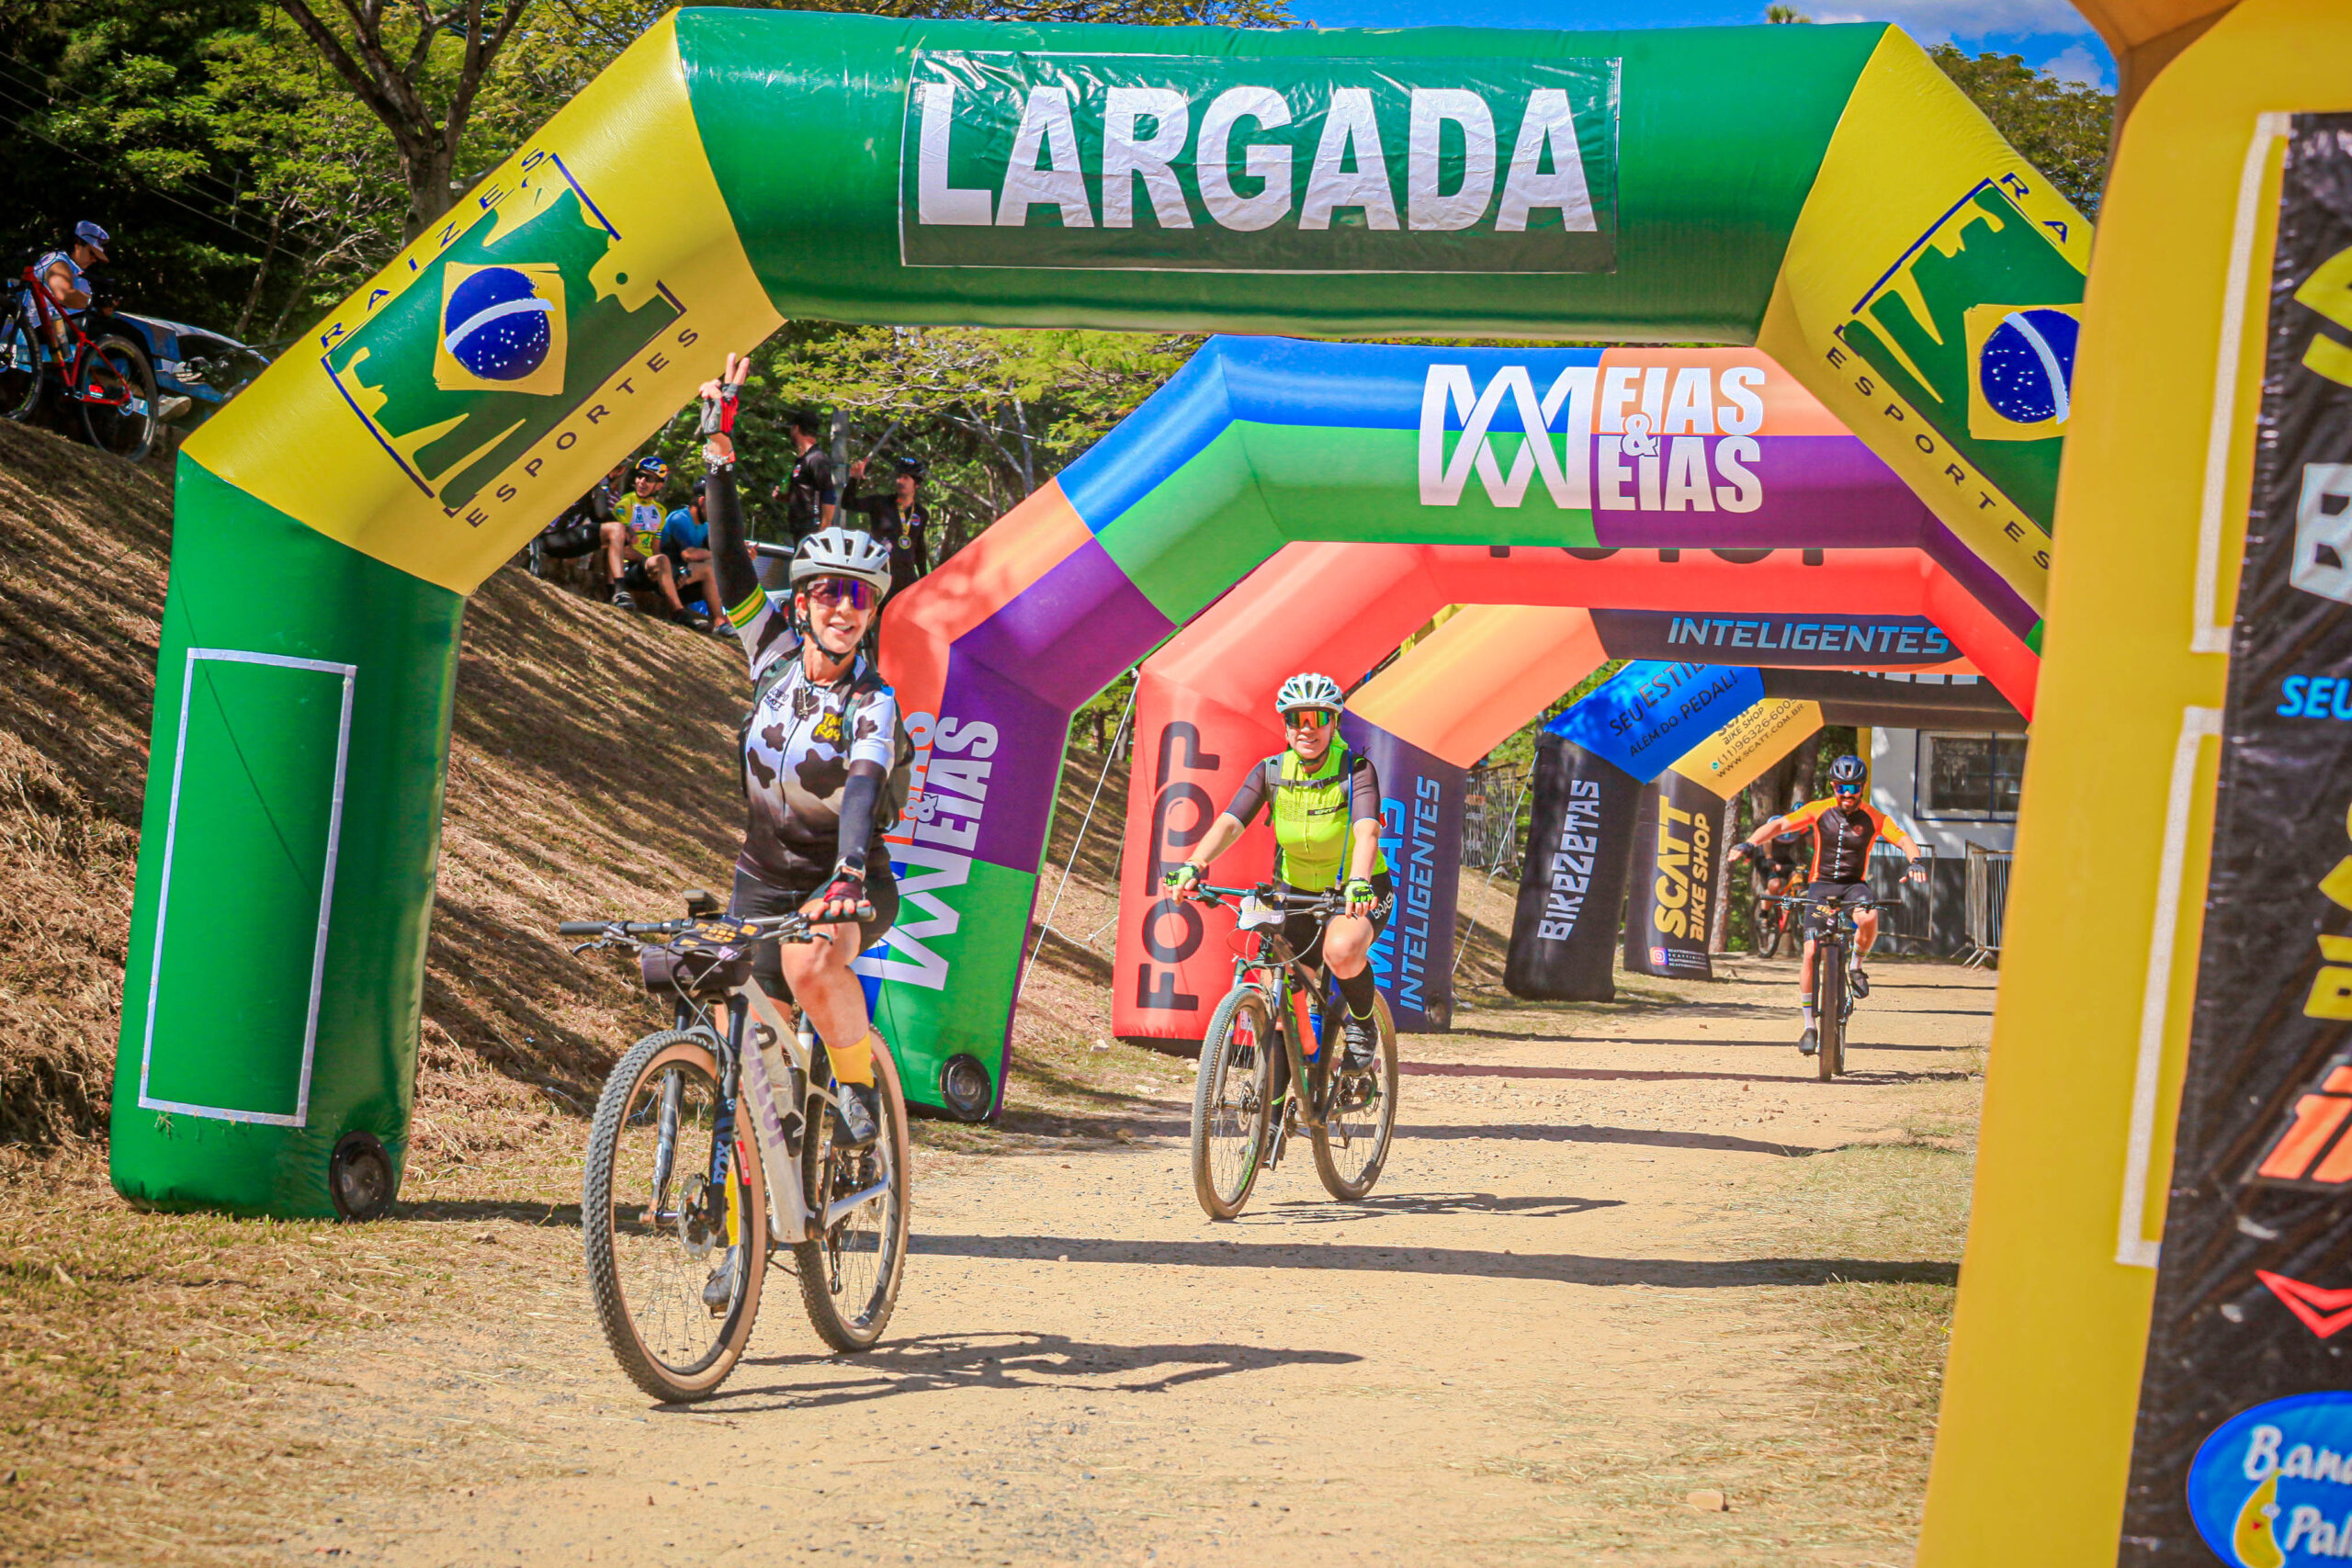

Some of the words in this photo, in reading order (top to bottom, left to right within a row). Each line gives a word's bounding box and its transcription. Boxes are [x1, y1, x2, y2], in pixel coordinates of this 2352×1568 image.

[919, 83, 1599, 232] LARGADA
[465, 328, 699, 529] ESPORTES
[1826, 346, 2051, 571] ESPORTES
[1668, 616, 1951, 654] INTELIGENTES
[1610, 703, 1645, 737] SEU
[1630, 728, 1661, 757] ALÉM
[1662, 716, 1679, 734] DO
[1679, 669, 1739, 719] PEDAL!
[1724, 727, 1744, 745] BIKE
[1743, 706, 1765, 728] SHOP
[1137, 721, 1221, 1011] FOTOP
[1656, 795, 1692, 940] SCATT
[1692, 811, 1711, 883] SHOP
[1399, 775, 1441, 1012] INTELIGENTES
[1690, 885, 1709, 942] BIKE
[712, 1140, 732, 1185] FOX
